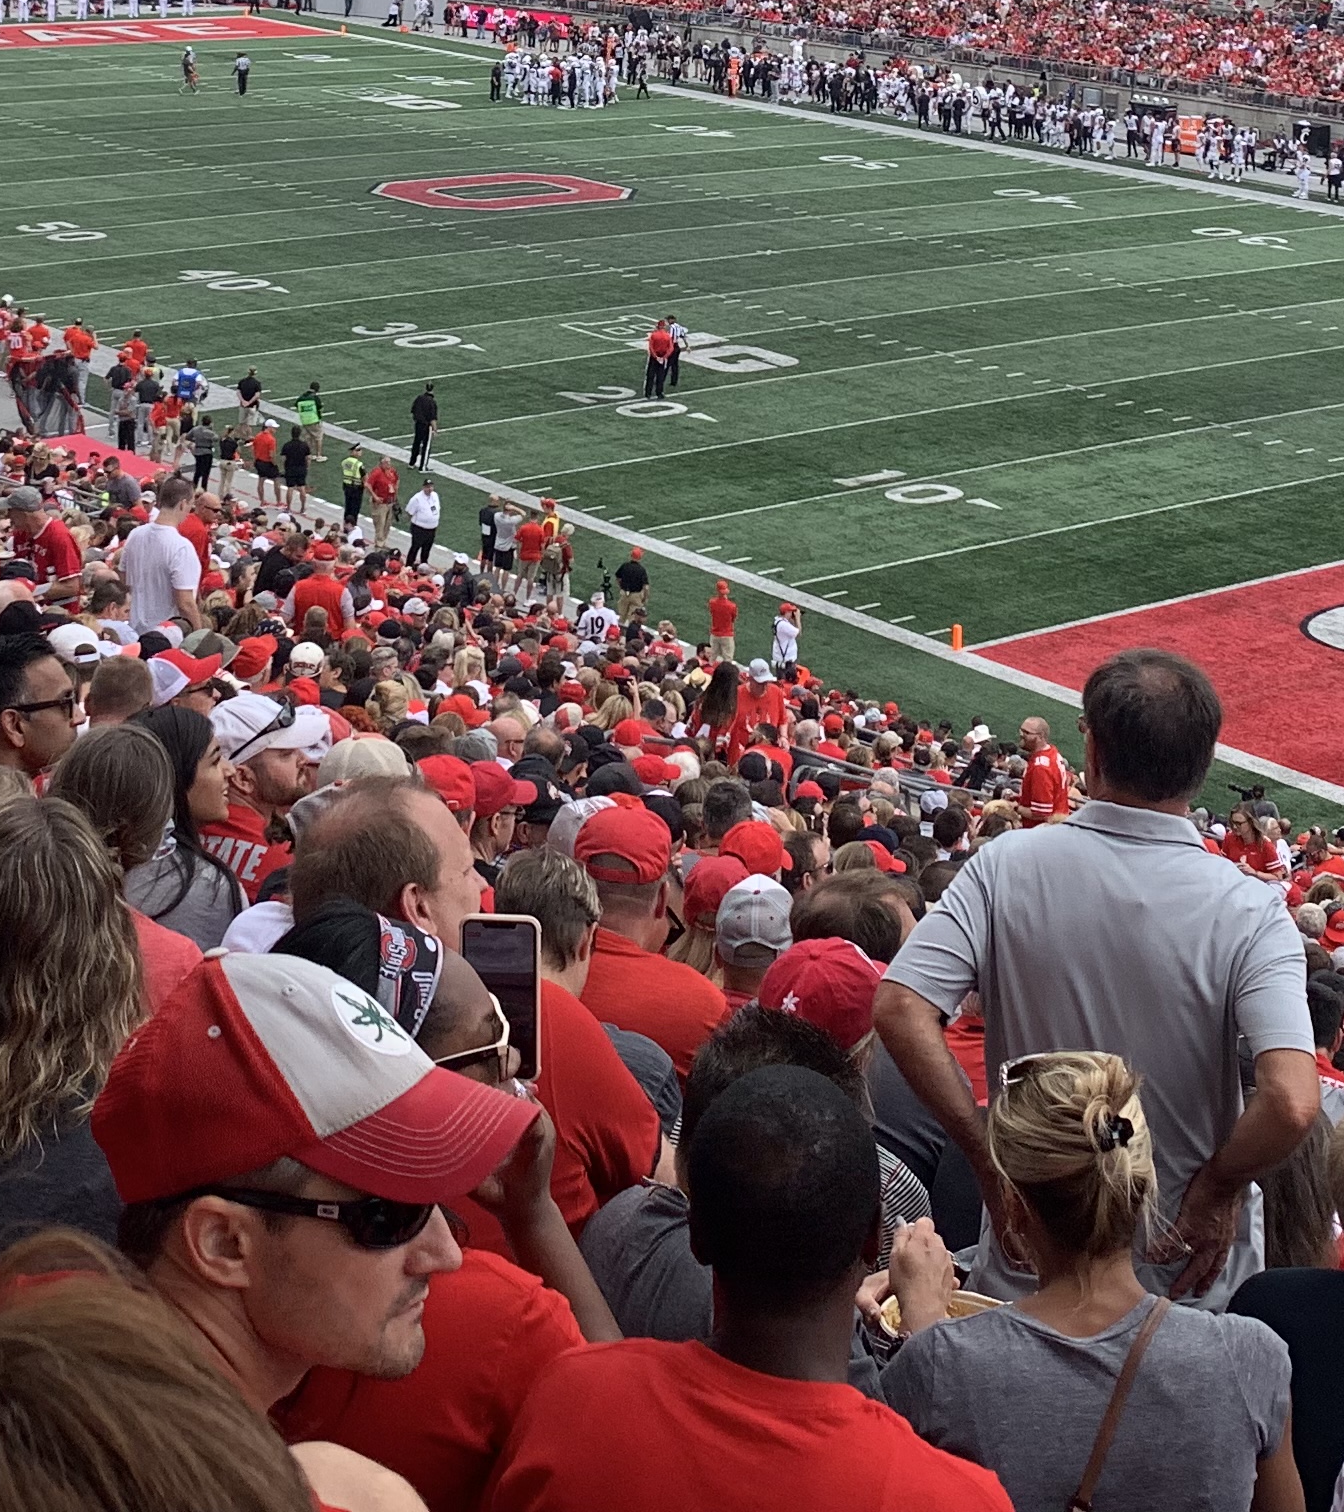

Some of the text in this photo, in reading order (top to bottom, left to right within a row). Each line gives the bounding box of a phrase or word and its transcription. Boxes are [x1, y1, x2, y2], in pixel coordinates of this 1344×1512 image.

[15, 220, 109, 242] 50
[176, 269, 272, 291] 40
[351, 322, 462, 349] 30
[554, 385, 686, 418] 20
[833, 469, 965, 505] 10
[589, 615, 605, 635] 19
